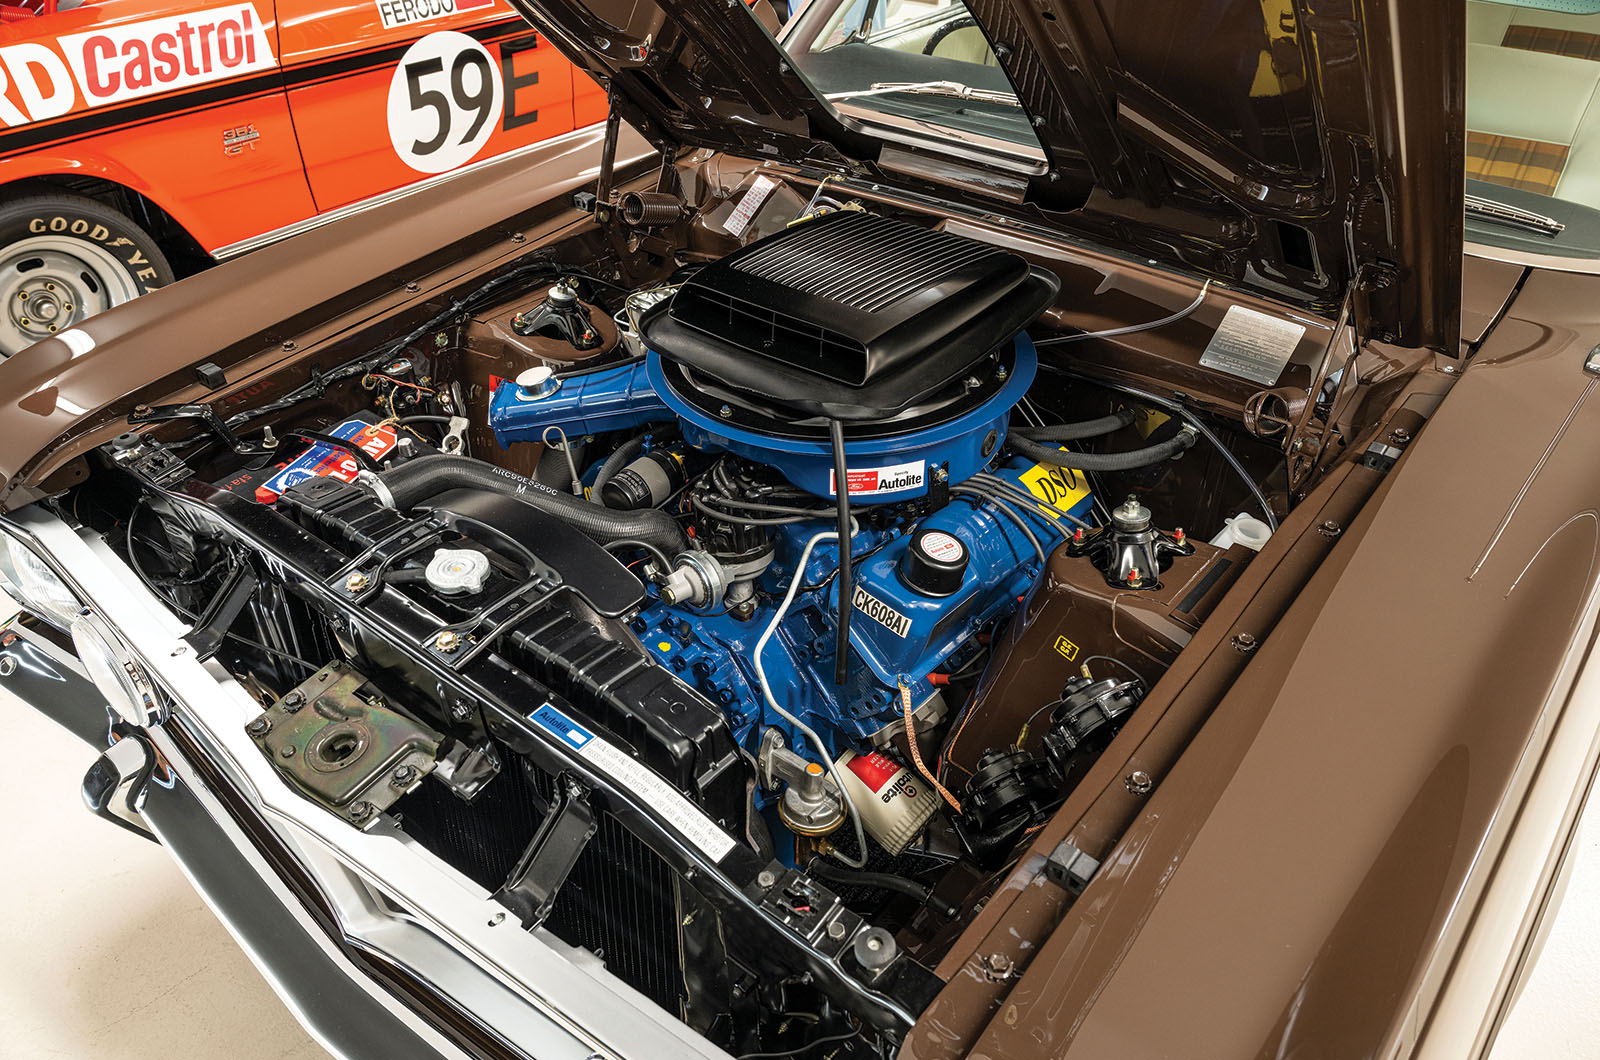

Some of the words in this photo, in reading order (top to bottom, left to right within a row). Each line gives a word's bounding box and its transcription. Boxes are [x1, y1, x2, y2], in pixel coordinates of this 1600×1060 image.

[380, 0, 454, 26] FERODO
[82, 9, 256, 98] Castrol
[404, 48, 494, 156] 59
[499, 34, 539, 132] E
[29, 216, 160, 293] GOODYE
[515, 483, 527, 495] M
[879, 475, 922, 490] Autolite
[539, 710, 570, 733] Autolite
[881, 771, 914, 804] utolite
